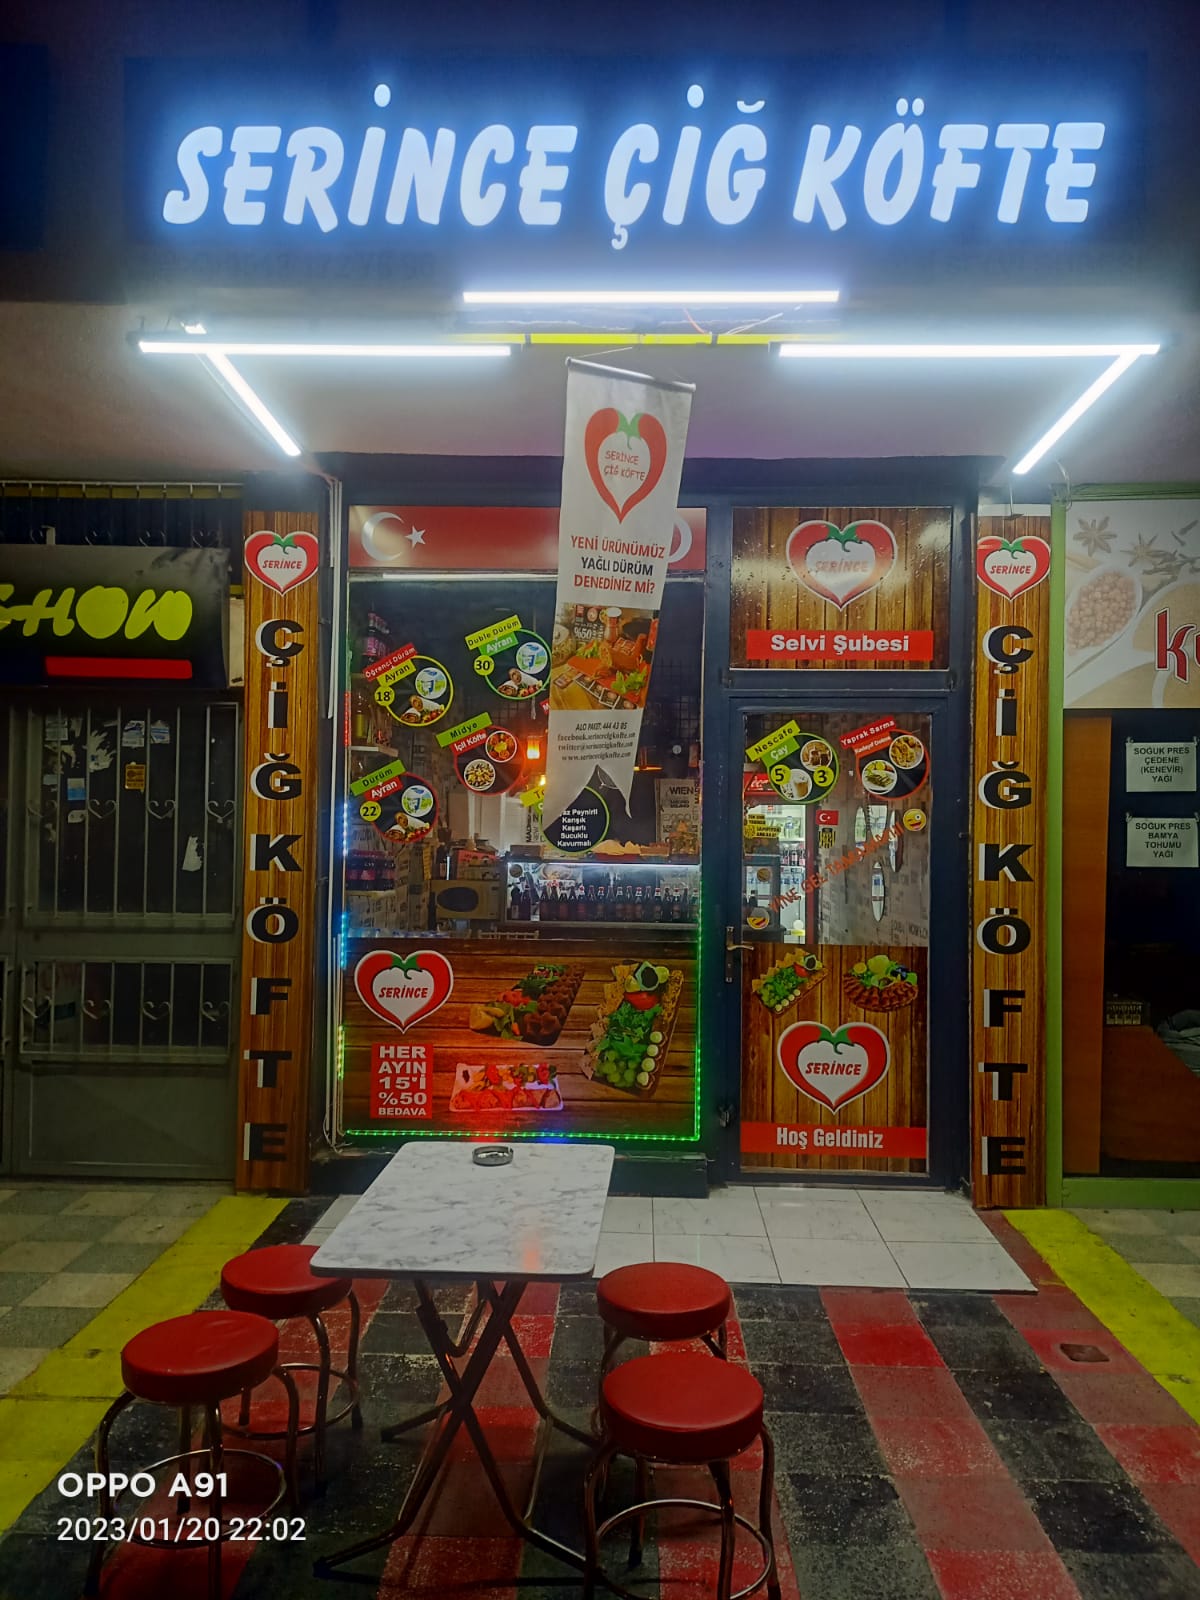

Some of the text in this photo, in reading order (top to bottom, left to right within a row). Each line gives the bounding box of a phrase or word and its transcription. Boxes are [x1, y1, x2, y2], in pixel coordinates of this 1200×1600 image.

[162, 84, 1106, 249] SERİNCE ÇİĞ KÖFTE
[571, 535, 665, 559] YENİ ÜRÜNÜMÜZ
[262, 558, 302, 570] SERİNCE
[581, 555, 653, 576] YAĞLI DÜRÜM
[990, 563, 1032, 575] SERİNCE
[574, 574, 656, 594] DENEDİNİZ Mİ?
[468, 633, 491, 646] Duble
[486, 637, 513, 653] Ayran
[771, 633, 909, 655] Selvi Şubesi
[385, 665, 410, 683] Ayran
[450, 723, 478, 739] Midye
[841, 720, 895, 747] Yaprak Sarma
[467, 732, 487, 747] Köfte
[755, 727, 794, 754] Nescafe
[770, 744, 789, 761] Çay
[1134, 746, 1190, 755] SOĞUK PRES
[1144, 757, 1179, 765] ÇEDENE
[774, 768, 785, 782] 5
[818, 769, 828, 783] 3
[1140, 765, 1183, 774] (KENEVİR)
[1152, 775, 1173, 783] YAĞI
[371, 780, 398, 799] Ayran
[1135, 822, 1191, 830] SOĞUK PRES
[1148, 832, 1179, 840] BAMYA
[1145, 841, 1181, 849] TOHUMU
[1153, 850, 1173, 858] YAĞI
[379, 985, 428, 999] SERİNCE
[379, 1046, 426, 1059] HER
[378, 1062, 427, 1074] AYIN
[805, 1060, 861, 1076] SERİNCE
[379, 1074, 426, 1089] 15'İ
[378, 1092, 427, 1105] %50
[378, 1107, 426, 1116] BEDAVA
[776, 1127, 883, 1150] Hoş Geldiniz
